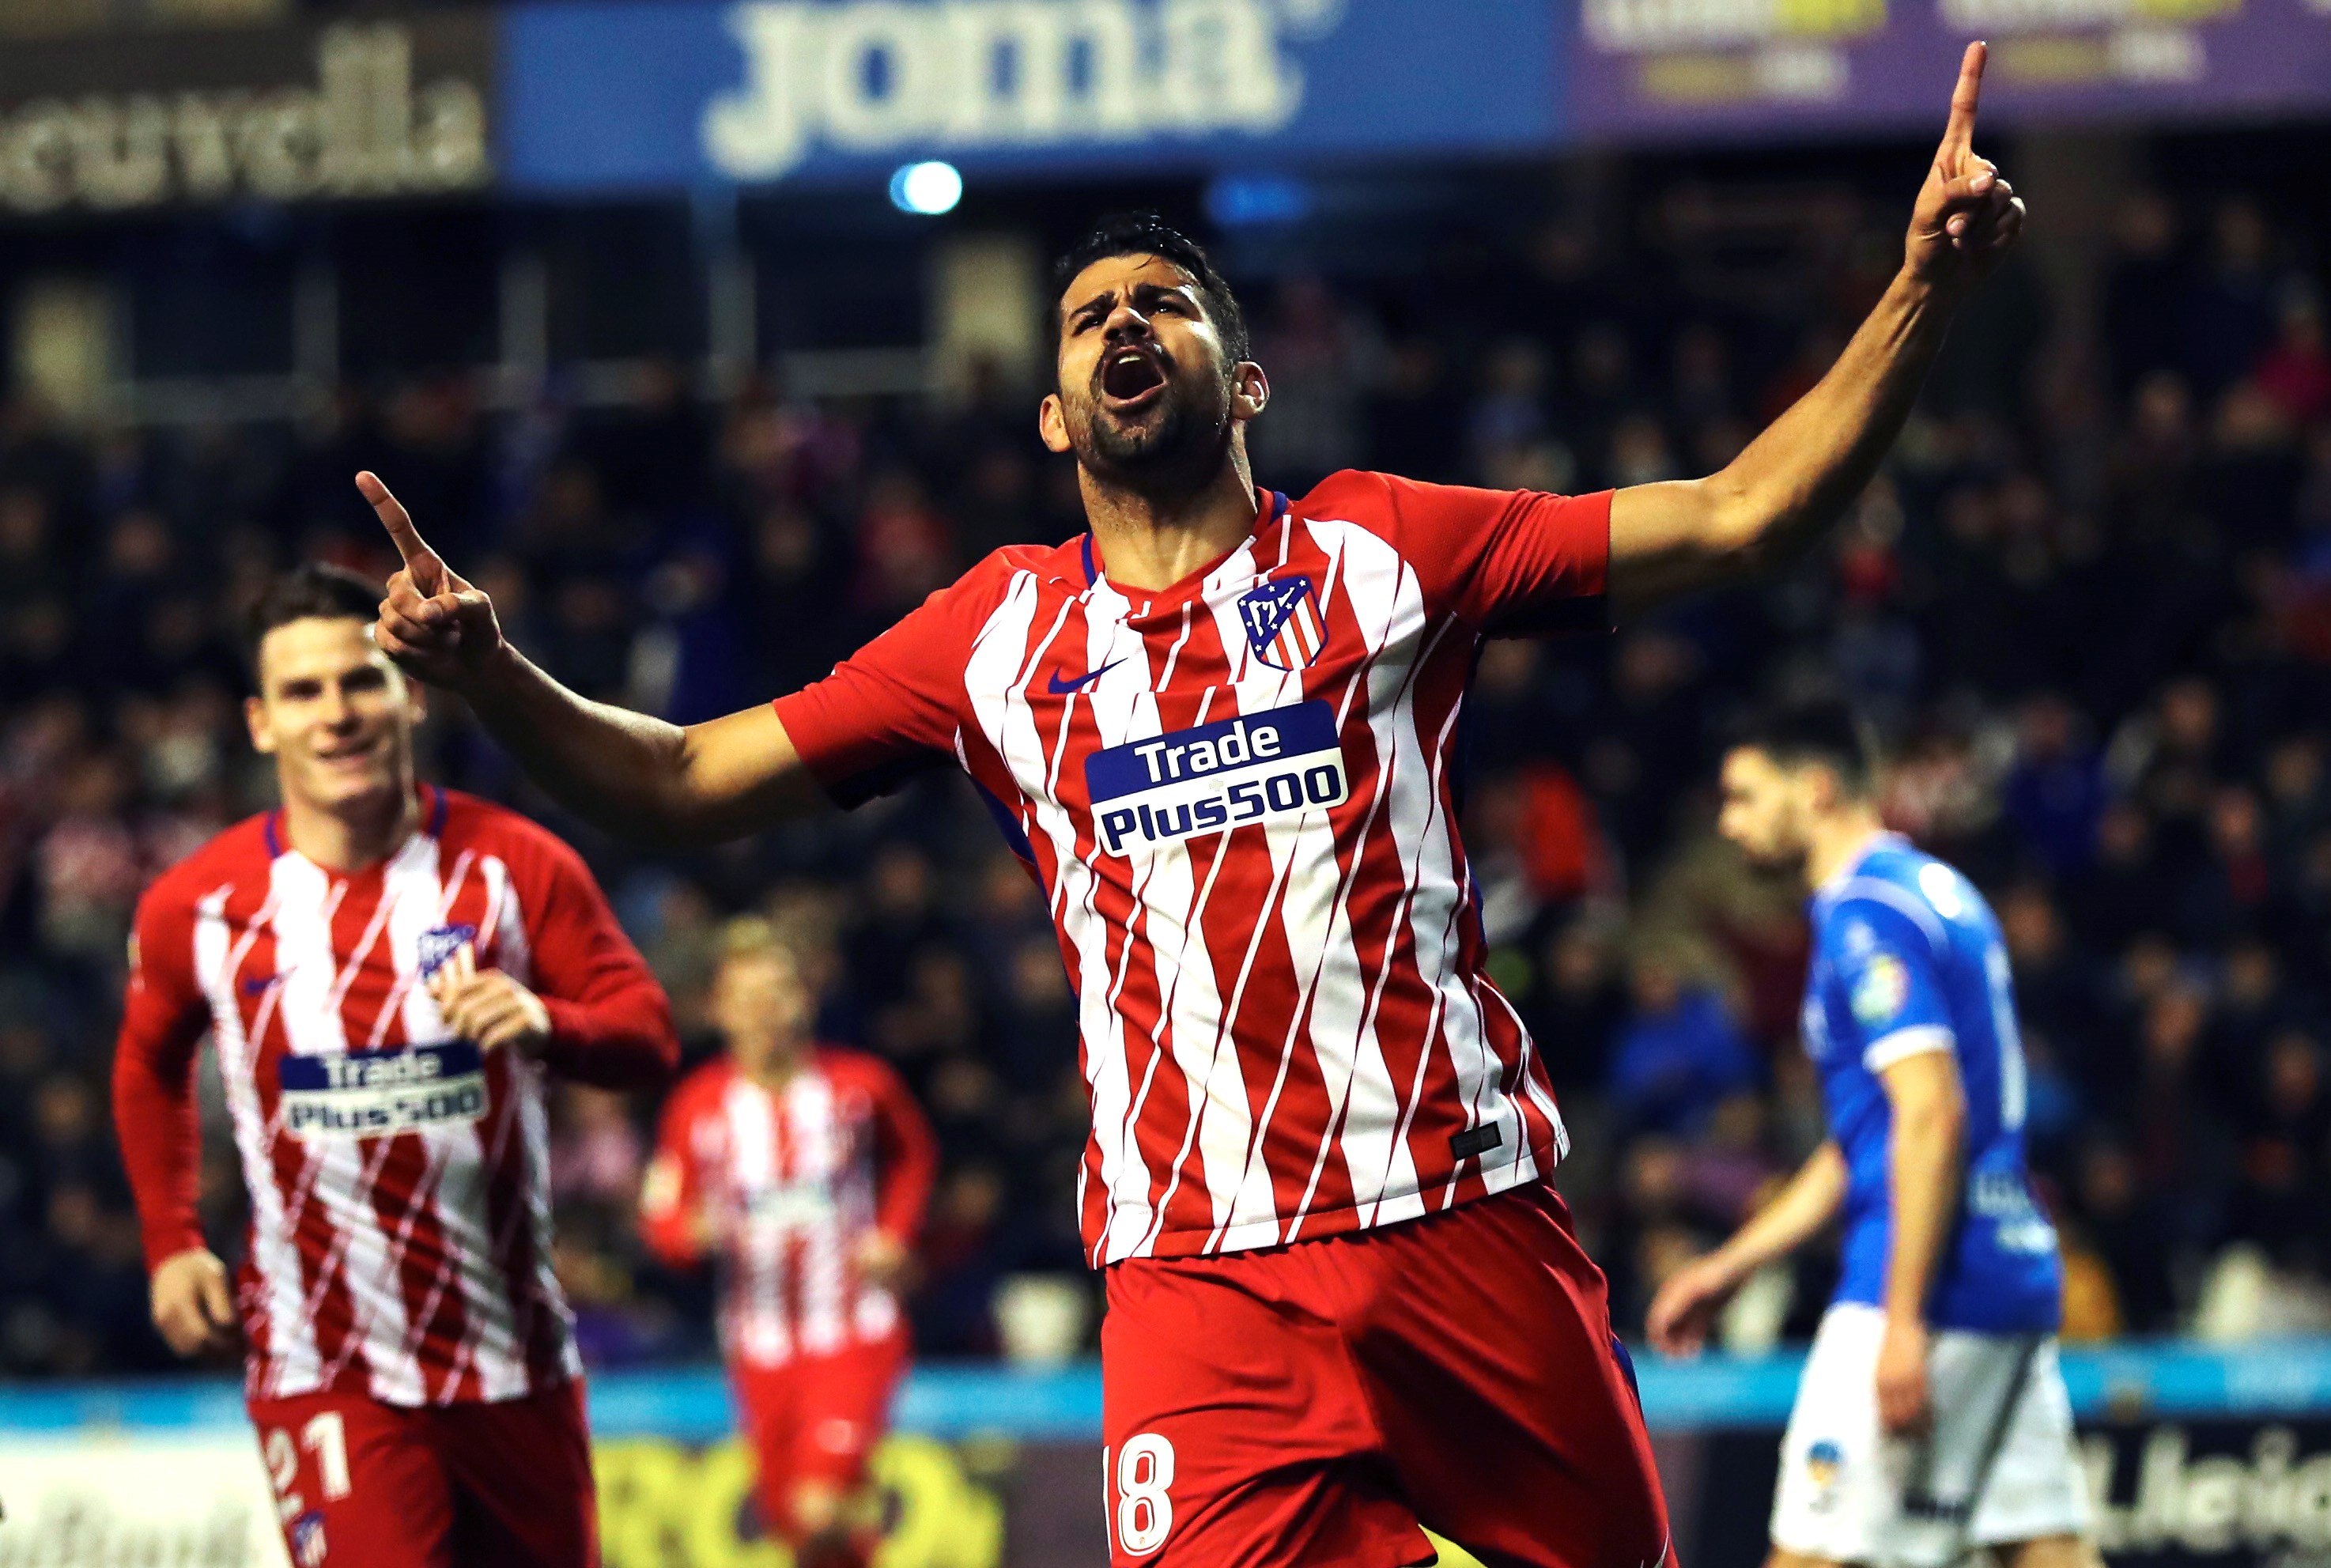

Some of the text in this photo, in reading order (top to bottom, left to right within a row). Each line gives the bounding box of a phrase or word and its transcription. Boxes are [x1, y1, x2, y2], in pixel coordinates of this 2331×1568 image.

[1135, 720, 1281, 784] Trade
[1101, 764, 1342, 852] Plus500
[319, 1047, 444, 1090] Trade
[289, 1086, 482, 1129] Plus500
[266, 1411, 353, 1521] 21
[1102, 1433, 1175, 1560] 8
